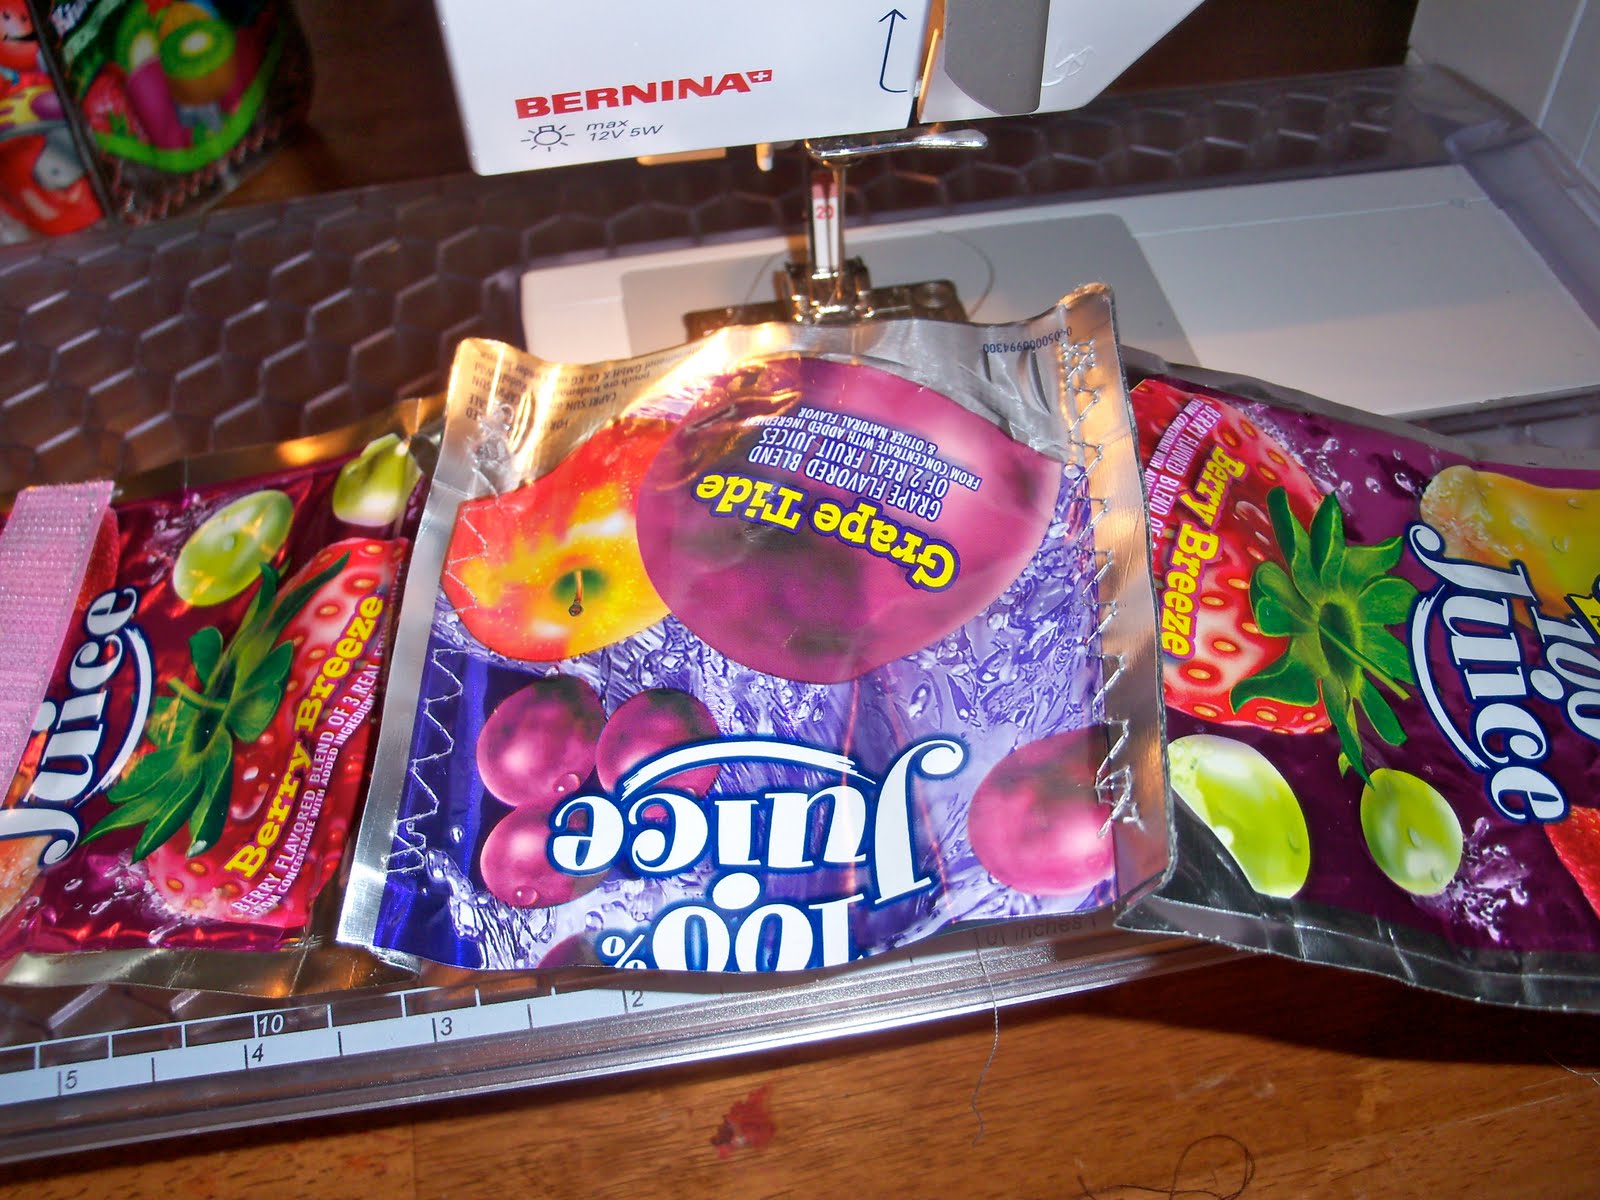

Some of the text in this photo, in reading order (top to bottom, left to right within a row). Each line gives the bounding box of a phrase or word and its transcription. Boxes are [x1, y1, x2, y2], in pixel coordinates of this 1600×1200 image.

[515, 73, 750, 119] BERNINA
[586, 119, 629, 131] max
[590, 125, 663, 141] 12V 5W
[816, 204, 834, 220] 20
[565, 397, 588, 412] SUN
[590, 391, 617, 407] CAPRI
[798, 407, 937, 455] & OTHER NATURAL FLAVOR
[1186, 404, 1222, 440] BERRY
[741, 414, 982, 491] FROM CONCENTRATE WITH ADDED INGREDIENT
[759, 427, 949, 499] OF 2 REAL FRUIT JUICES
[1149, 449, 1167, 470] WITH
[1165, 432, 1199, 476] FLAVORED
[749, 445, 941, 521] GRAPE FLAVORED BLEND
[1150, 474, 1181, 516] BLEND
[696, 474, 955, 588] Grape Tide
[1162, 446, 1247, 657] Berry Breeze
[1409, 524, 1564, 819] Juice
[0, 587, 138, 865] Juice
[224, 595, 383, 878] Berry Breeze
[232, 872, 282, 912] BERRY
[274, 789, 316, 870] FLAVORED
[309, 731, 335, 783] BLEND
[328, 706, 350, 727] OF
[342, 695, 361, 707] 3
[249, 693, 377, 918] FROM CONCENTRATE WITH ADDED INGREDIENT
[552, 740, 965, 909] Juice
[631, 988, 644, 1008] 2
[259, 1013, 284, 1035] 10
[441, 1015, 454, 1036] 3
[251, 1043, 265, 1063] 4
[65, 1070, 78, 1090] 5
